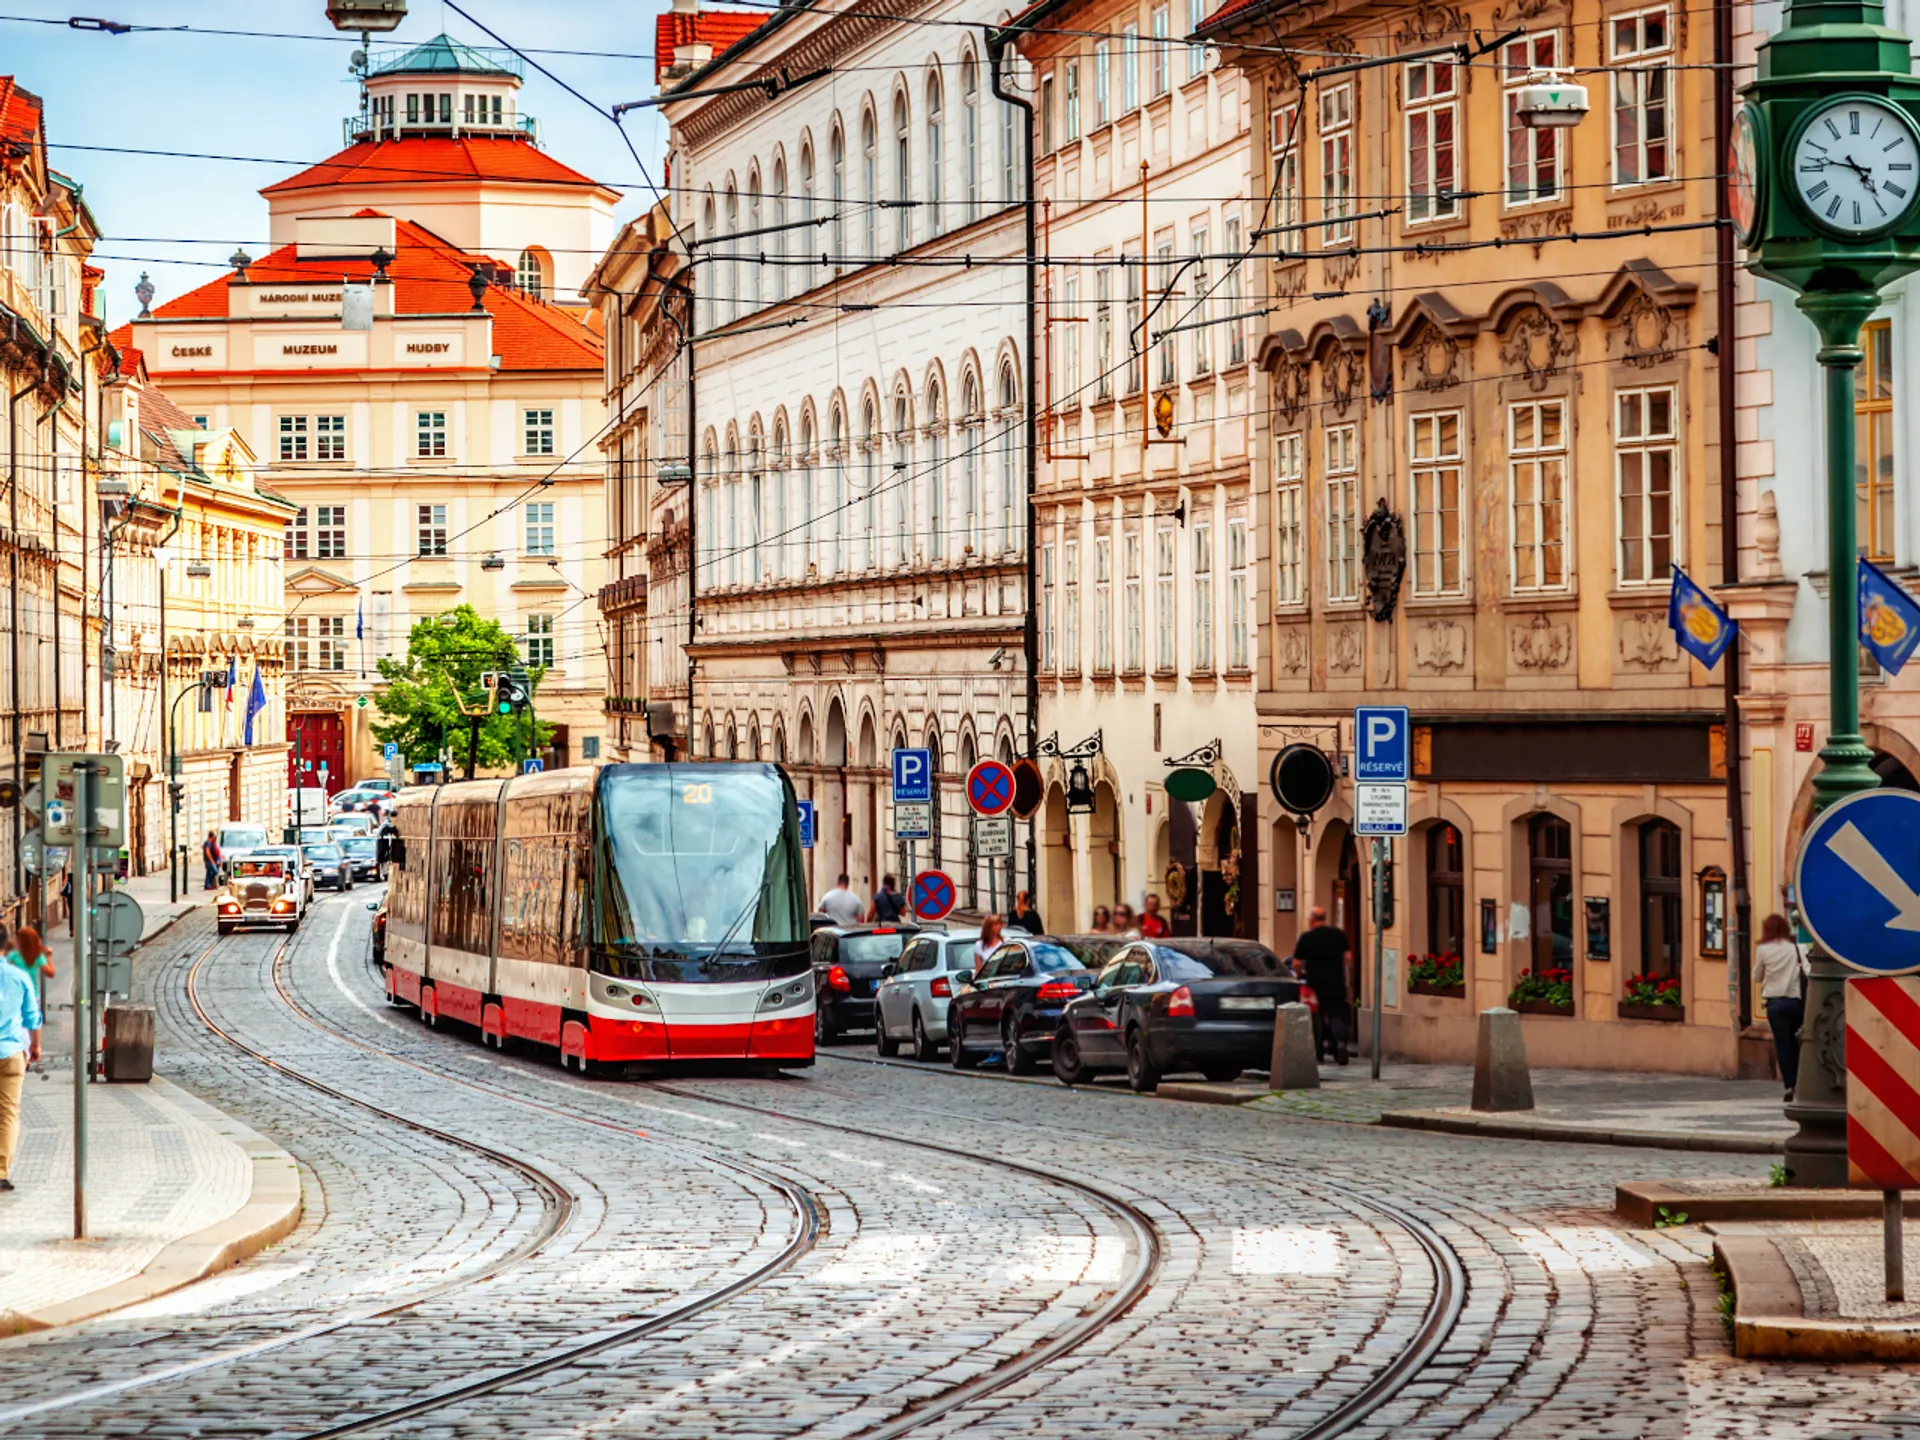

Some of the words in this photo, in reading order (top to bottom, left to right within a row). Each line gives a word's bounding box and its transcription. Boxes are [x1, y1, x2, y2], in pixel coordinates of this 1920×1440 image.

[260, 292, 309, 303] NÁRODNÍ
[312, 293, 343, 302] MUZE
[172, 344, 213, 357] ČESKÉ
[283, 344, 337, 355] MUZEUM
[406, 343, 450, 353] HUDBY
[1367, 716, 1396, 757] P
[901, 755, 922, 785] P
[1359, 761, 1404, 772] RÉSERVÉ
[683, 784, 712, 804] 20
